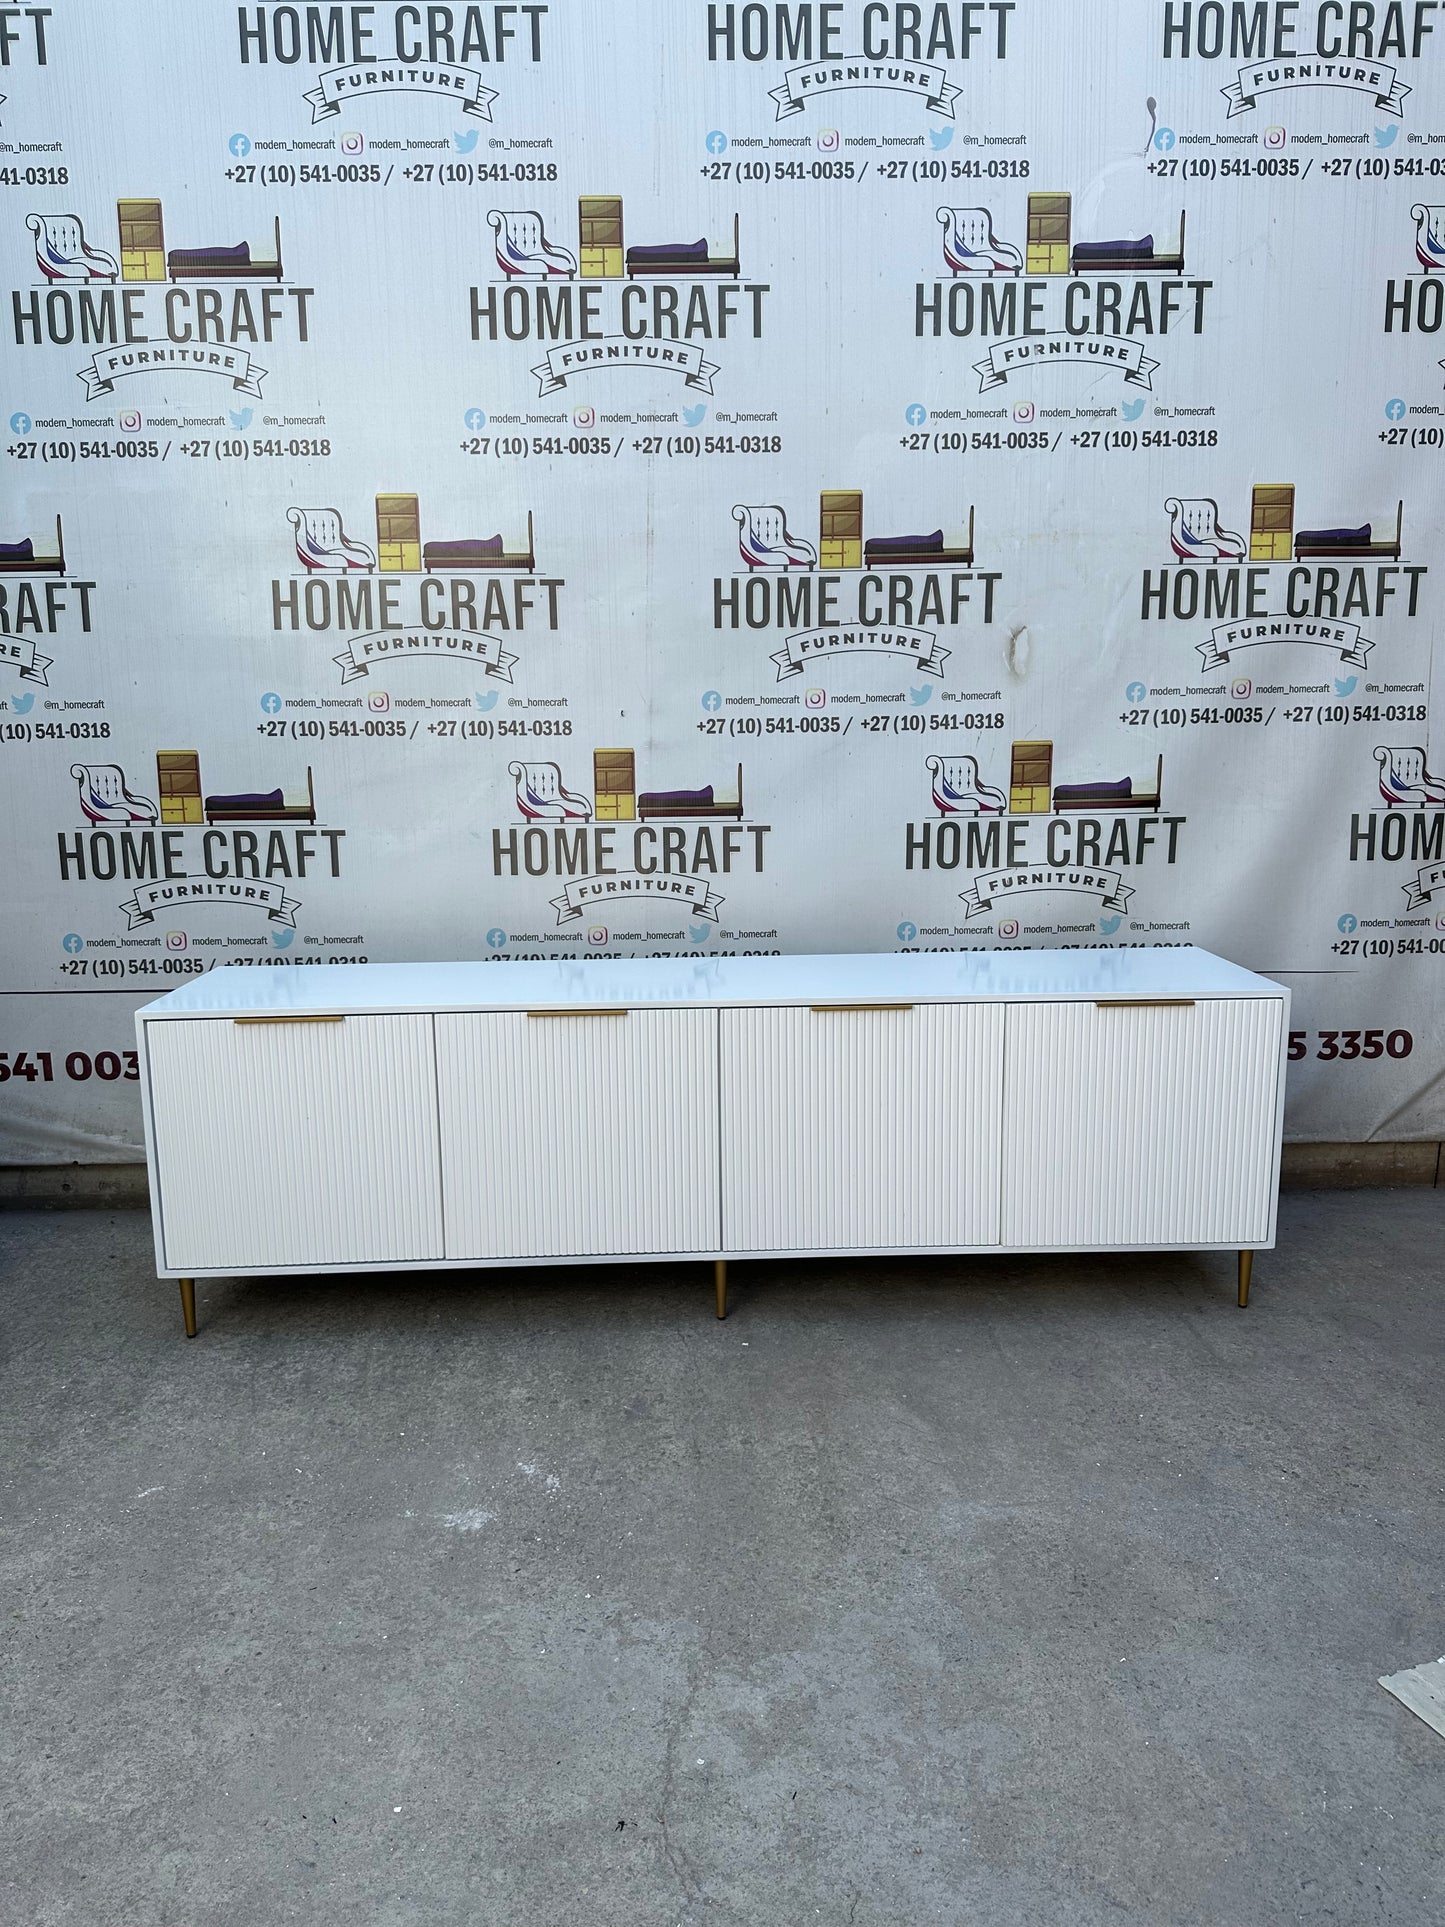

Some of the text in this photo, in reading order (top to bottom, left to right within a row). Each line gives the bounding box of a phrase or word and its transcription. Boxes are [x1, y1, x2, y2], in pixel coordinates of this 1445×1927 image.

[238, 5, 548, 64] HOME CRAFT
[708, 3, 1015, 61] HOME CRAFT
[1163, 1, 1445, 59] HOME CRAF
[335, 70, 465, 91] FURNITURE
[801, 67, 930, 88] FURNITURE
[1254, 65, 1381, 85] FURNITURE
[0, 142, 63, 154] @m_homecraft
[489, 138, 553, 150] @m_homecraft
[963, 135, 1026, 147] @m_homecraft
[1407, 133, 1445, 145] @m_hom
[0, 167, 68, 185] 41-0318
[225, 165, 256, 182] +27
[261, 165, 295, 186] (10)
[403, 164, 434, 181] +27
[439, 164, 473, 185] (10)
[478, 164, 557, 181] 541-0318
[700, 162, 731, 179] +27
[736, 162, 770, 183] (10)
[877, 161, 908, 178] +27
[913, 161, 946, 182] (10)
[951, 160, 1029, 178] 541-0318
[1147, 159, 1178, 176] +27
[1182, 159, 1216, 180] (10)
[1321, 159, 1352, 175] +27
[1356, 158, 1389, 179] (10)
[1394, 158, 1445, 176] 541-0
[12, 288, 314, 344] HOME CRAFT
[470, 285, 770, 340] HOME CRAFT
[916, 281, 1213, 337] HOME CRAFT
[1384, 279, 1444, 333] HO
[109, 350, 235, 370] FURNITURE
[563, 346, 688, 366] FURNITURE
[1004, 342, 1128, 362] FURNITURE
[263, 415, 326, 427] @m_homecraft
[716, 412, 777, 424] @m_homecraft
[1154, 406, 1215, 418] @m_homecraft
[460, 438, 490, 454] +27
[495, 438, 528, 458] (10)
[633, 437, 662, 454] +27
[667, 437, 700, 457] (10)
[705, 436, 781, 453] 541-0318
[900, 434, 930, 450] +27
[934, 433, 967, 453] (10)
[1070, 431, 1100, 447] +27
[1105, 431, 1137, 451] (10)
[1142, 430, 1217, 447] 541-0318
[1379, 428, 1444, 448] +27 (10)
[7, 442, 37, 459] +27
[42, 442, 76, 462] (10)
[180, 441, 210, 457] +27
[215, 440, 249, 460] (10)
[253, 439, 331, 456] 541-0318
[714, 573, 1002, 629] HOME CRAFT
[1141, 567, 1428, 620] HOME CRAFT
[0, 582, 96, 633] AFT
[272, 579, 565, 631] HOME CRAFT
[800, 633, 921, 652] FURNITURE
[1227, 624, 1345, 643] FURNITURE
[364, 636, 487, 655] FURNITURE
[942, 691, 1001, 702] @m_homecraft
[1365, 683, 1424, 694] @m_homecraft
[44, 700, 105, 711] @m_homecraft
[508, 698, 568, 708] @m_homecraft
[697, 719, 725, 734] +27
[730, 718, 761, 737] (10)
[861, 716, 890, 731] +27
[894, 715, 925, 734] (10)
[930, 713, 1004, 730] 541-0318
[1120, 710, 1149, 725] +27
[1153, 709, 1186, 728] (10)
[1283, 707, 1313, 722] +27
[1317, 706, 1349, 725] (10)
[1353, 705, 1426, 721] 541-0318
[0, 723, 110, 743] (10) 541-0318
[257, 721, 286, 736] +27
[292, 721, 325, 740] (10)
[428, 721, 457, 736] +27
[461, 721, 494, 740] (10)
[498, 720, 572, 736] 541-0318
[906, 817, 1186, 869] HOME CRAFT
[1350, 813, 1445, 861] HOM
[58, 830, 346, 880] HOME CRAFT
[493, 826, 771, 876] HOME CRAFT
[579, 880, 695, 898] FURNITURE
[989, 873, 1108, 891] FURNITURE
[149, 884, 270, 902] FURNITURE
[720, 929, 777, 940] @m_homecraft
[1130, 921, 1190, 932] @m_homecraft
[304, 935, 364, 945] @m_homecraft
[1331, 939, 1445, 958] +27 (10) 541-00
[60, 960, 88, 975] +27
[93, 960, 124, 978] (10)
[1316, 1030, 1413, 1060] 3350
[66, 1051, 140, 1081] 003
